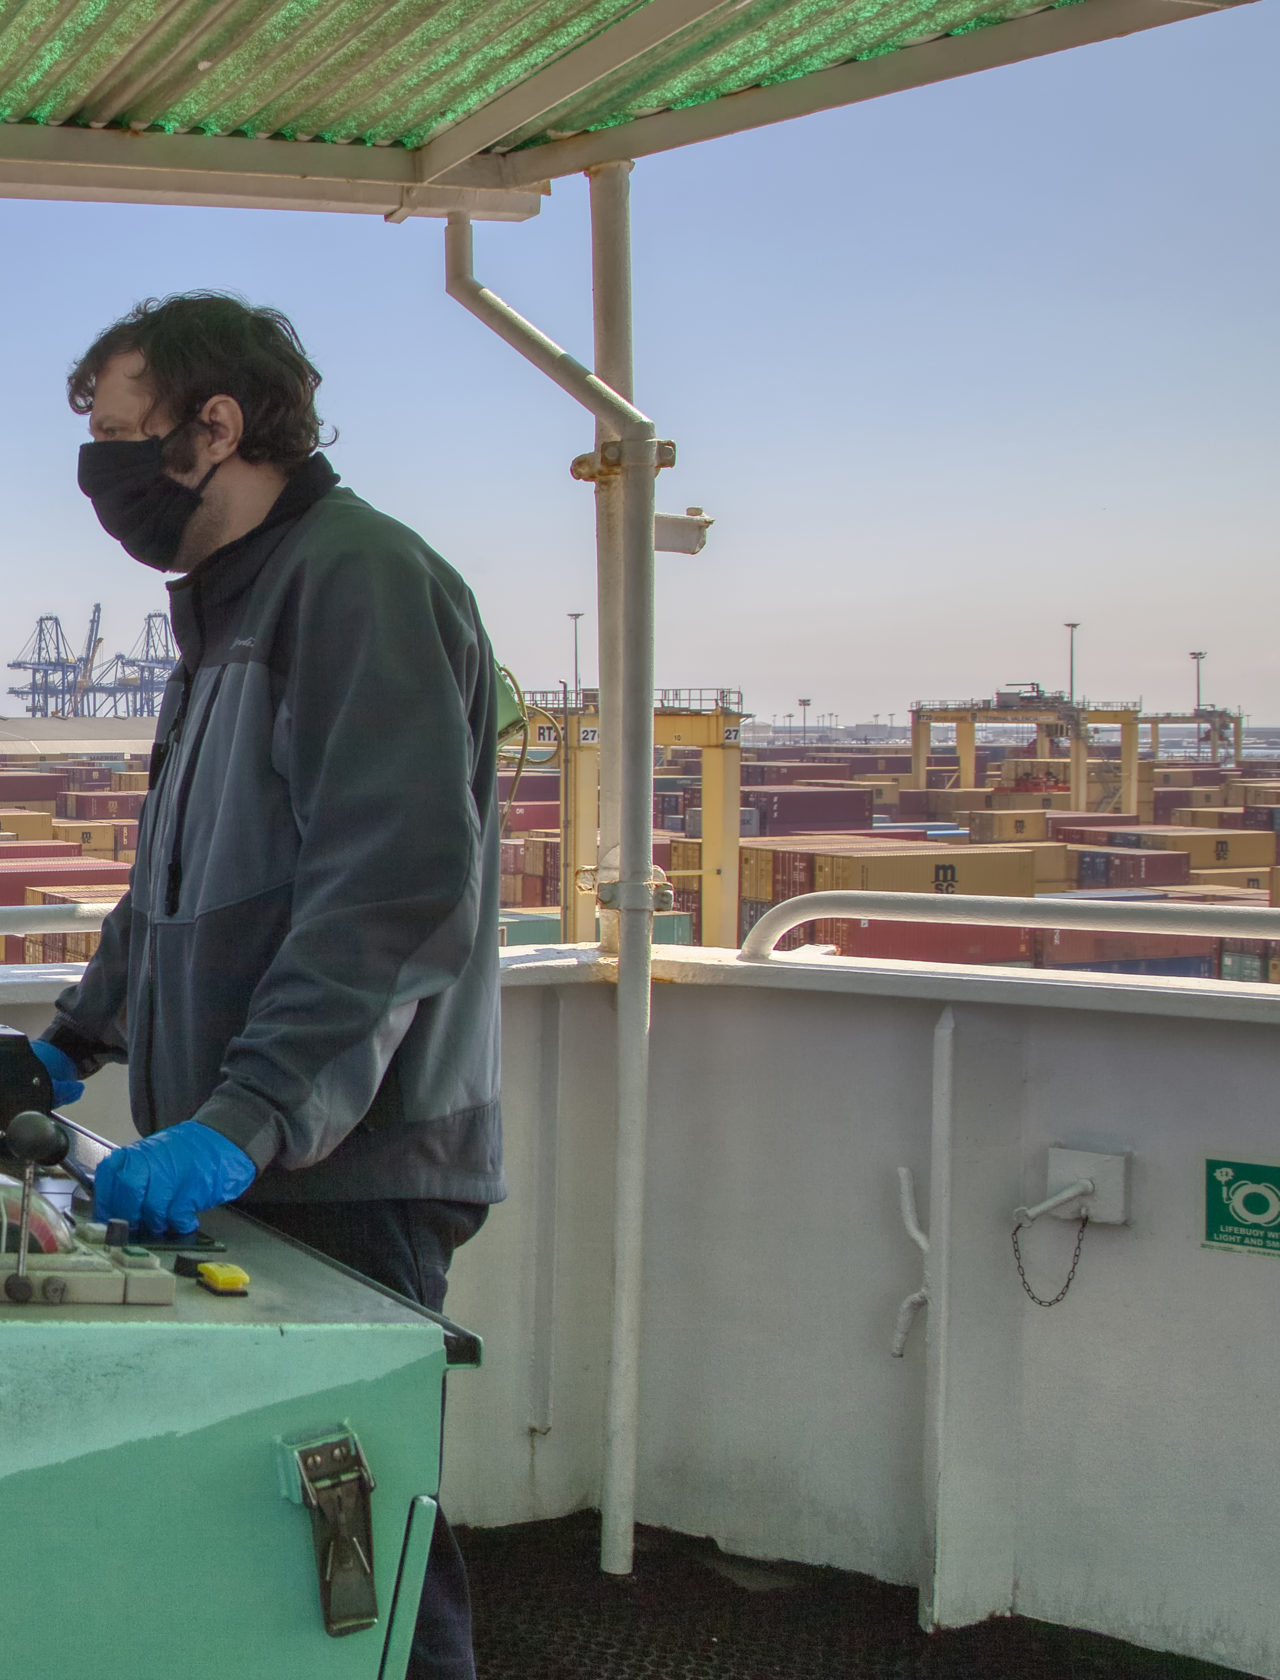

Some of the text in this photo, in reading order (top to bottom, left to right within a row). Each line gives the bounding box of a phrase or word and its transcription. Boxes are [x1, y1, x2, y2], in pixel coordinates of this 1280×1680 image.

[582, 729, 597, 741] 27
[724, 729, 739, 740] 27
[1220, 1225, 1264, 1237] LIFEBUOY
[1213, 1233, 1241, 1243] LIGHT
[1244, 1237, 1263, 1246] AND
